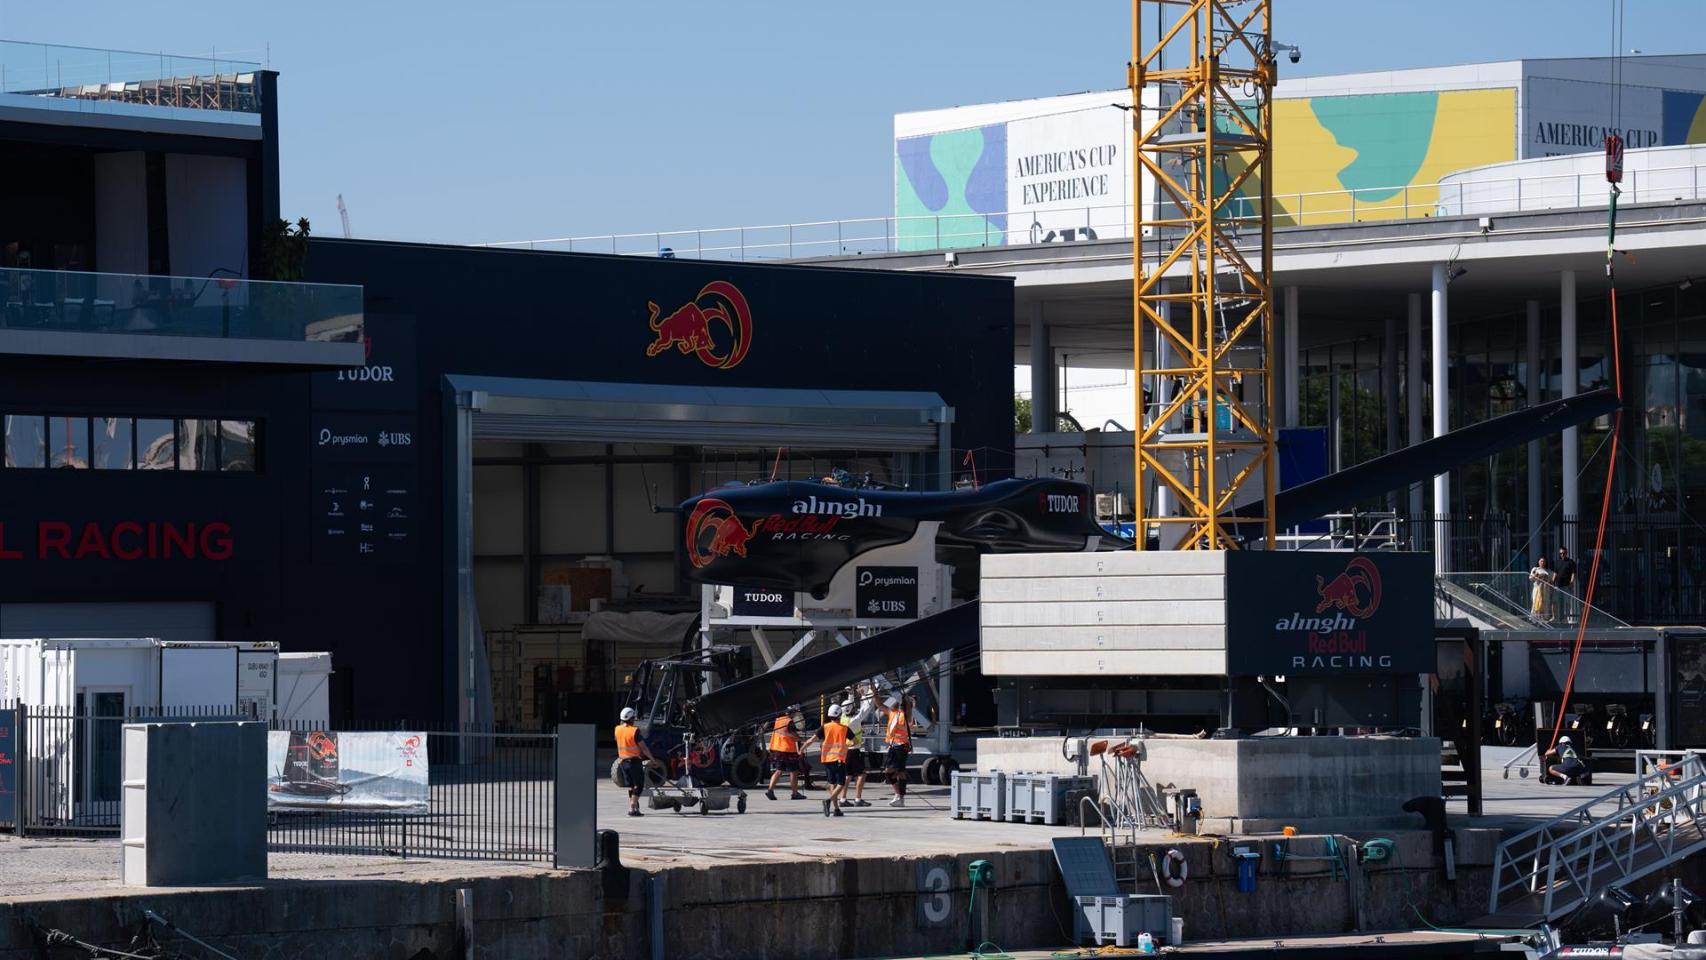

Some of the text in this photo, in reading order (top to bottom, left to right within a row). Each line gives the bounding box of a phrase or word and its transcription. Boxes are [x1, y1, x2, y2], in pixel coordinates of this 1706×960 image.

[1626, 128, 1657, 148] CUP
[1015, 144, 1116, 178] AMERICA'S CUP
[1023, 174, 1108, 205] EXPERIENCE
[337, 366, 394, 382] TUDOR
[332, 433, 368, 446] prysmian
[390, 433, 412, 445] UBS
[792, 496, 883, 519] alinghi
[1047, 494, 1080, 513] TUDOR
[762, 512, 841, 533] Red Bull
[38, 521, 233, 561] RACING
[771, 532, 852, 542] RACING
[874, 576, 916, 587] prysmian
[744, 593, 783, 603] TUDOR
[882, 600, 906, 612] UBS
[1275, 612, 1356, 634] alinghi
[1308, 632, 1366, 653] Red Bull
[1292, 655, 1392, 668] RACING
[924, 867, 951, 923] 3
[1572, 947, 1610, 955] TUDOR
